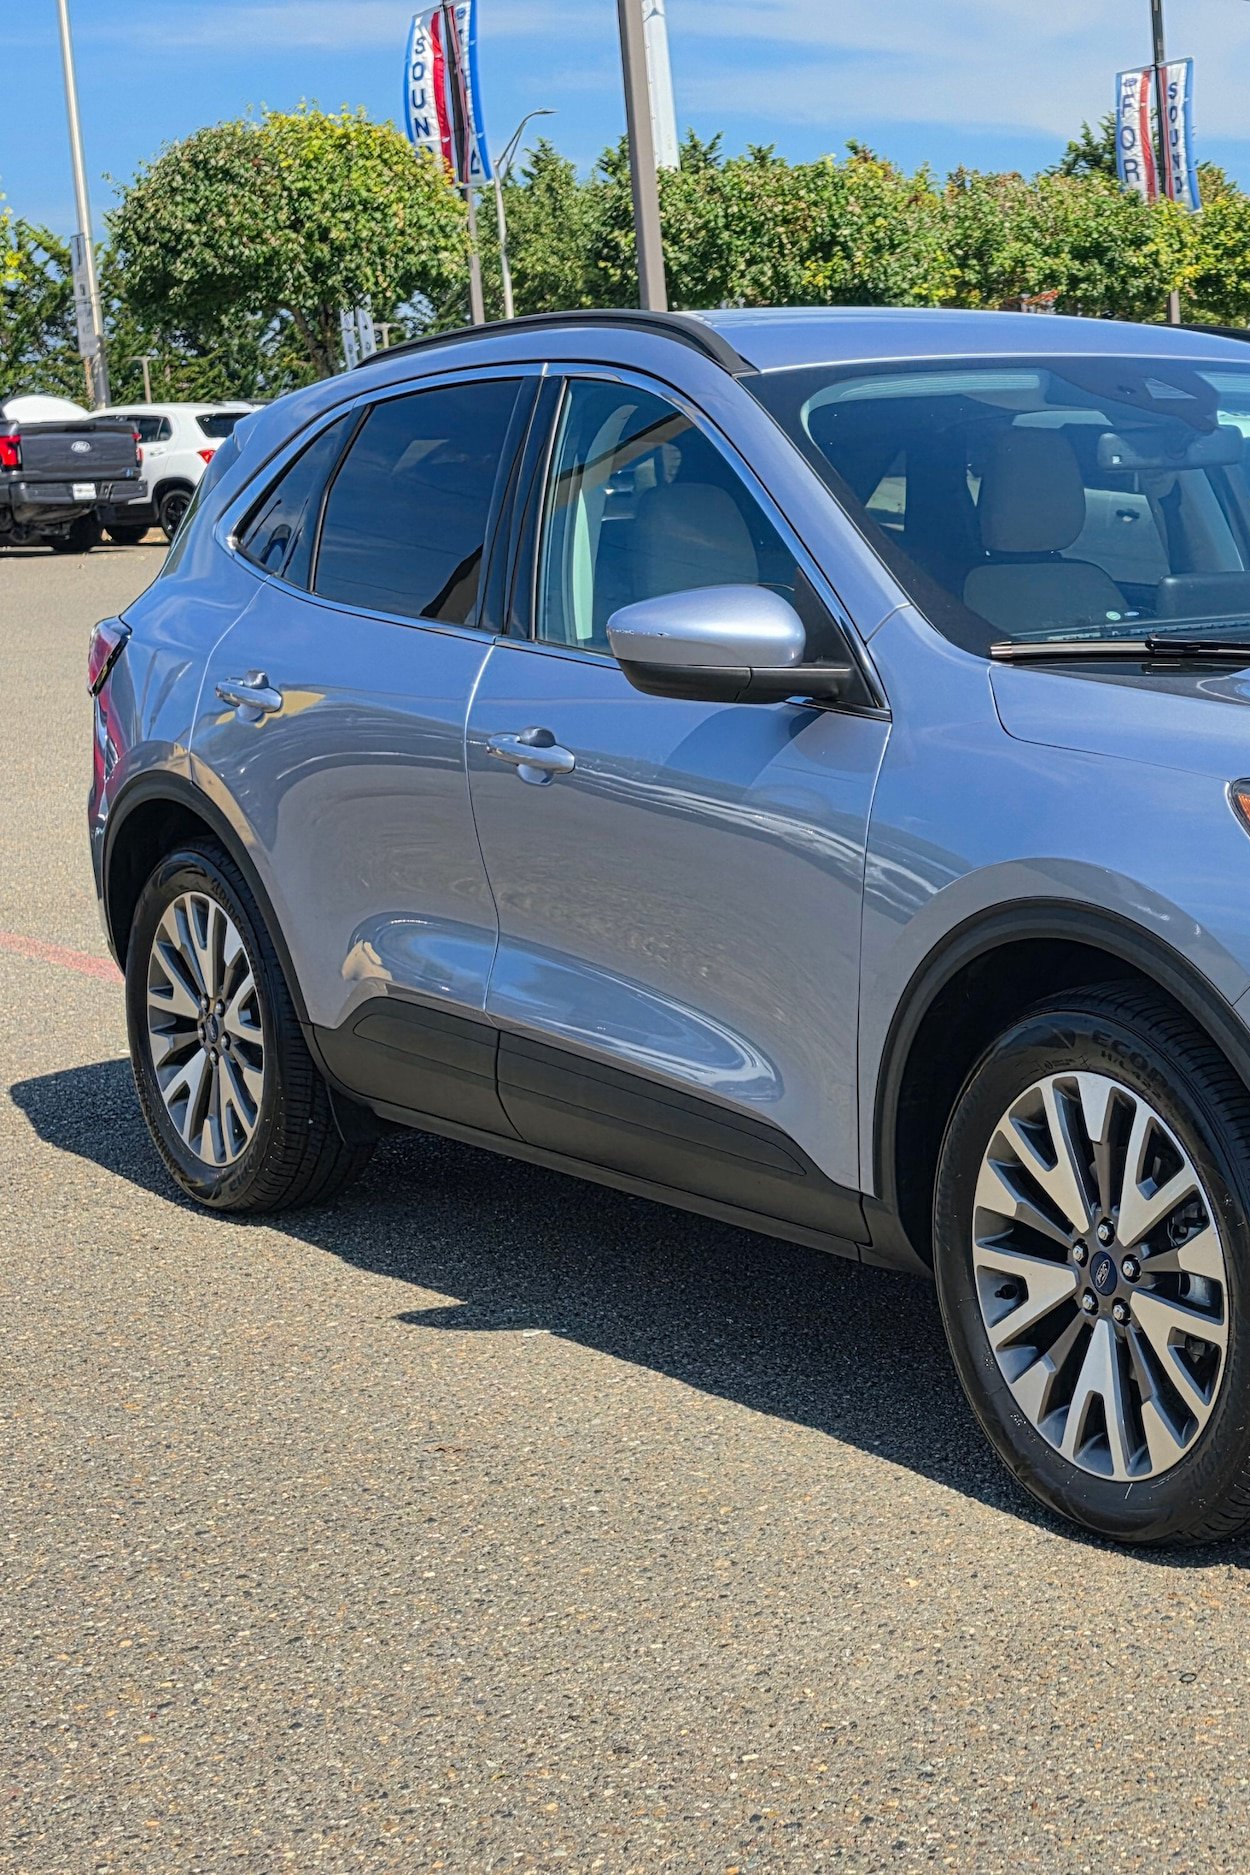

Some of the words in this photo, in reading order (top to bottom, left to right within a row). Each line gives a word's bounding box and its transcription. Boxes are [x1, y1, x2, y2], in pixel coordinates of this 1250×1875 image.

[411, 36, 433, 153] SOUN
[1120, 94, 1140, 183] FOR
[1167, 81, 1183, 194] SOUND
